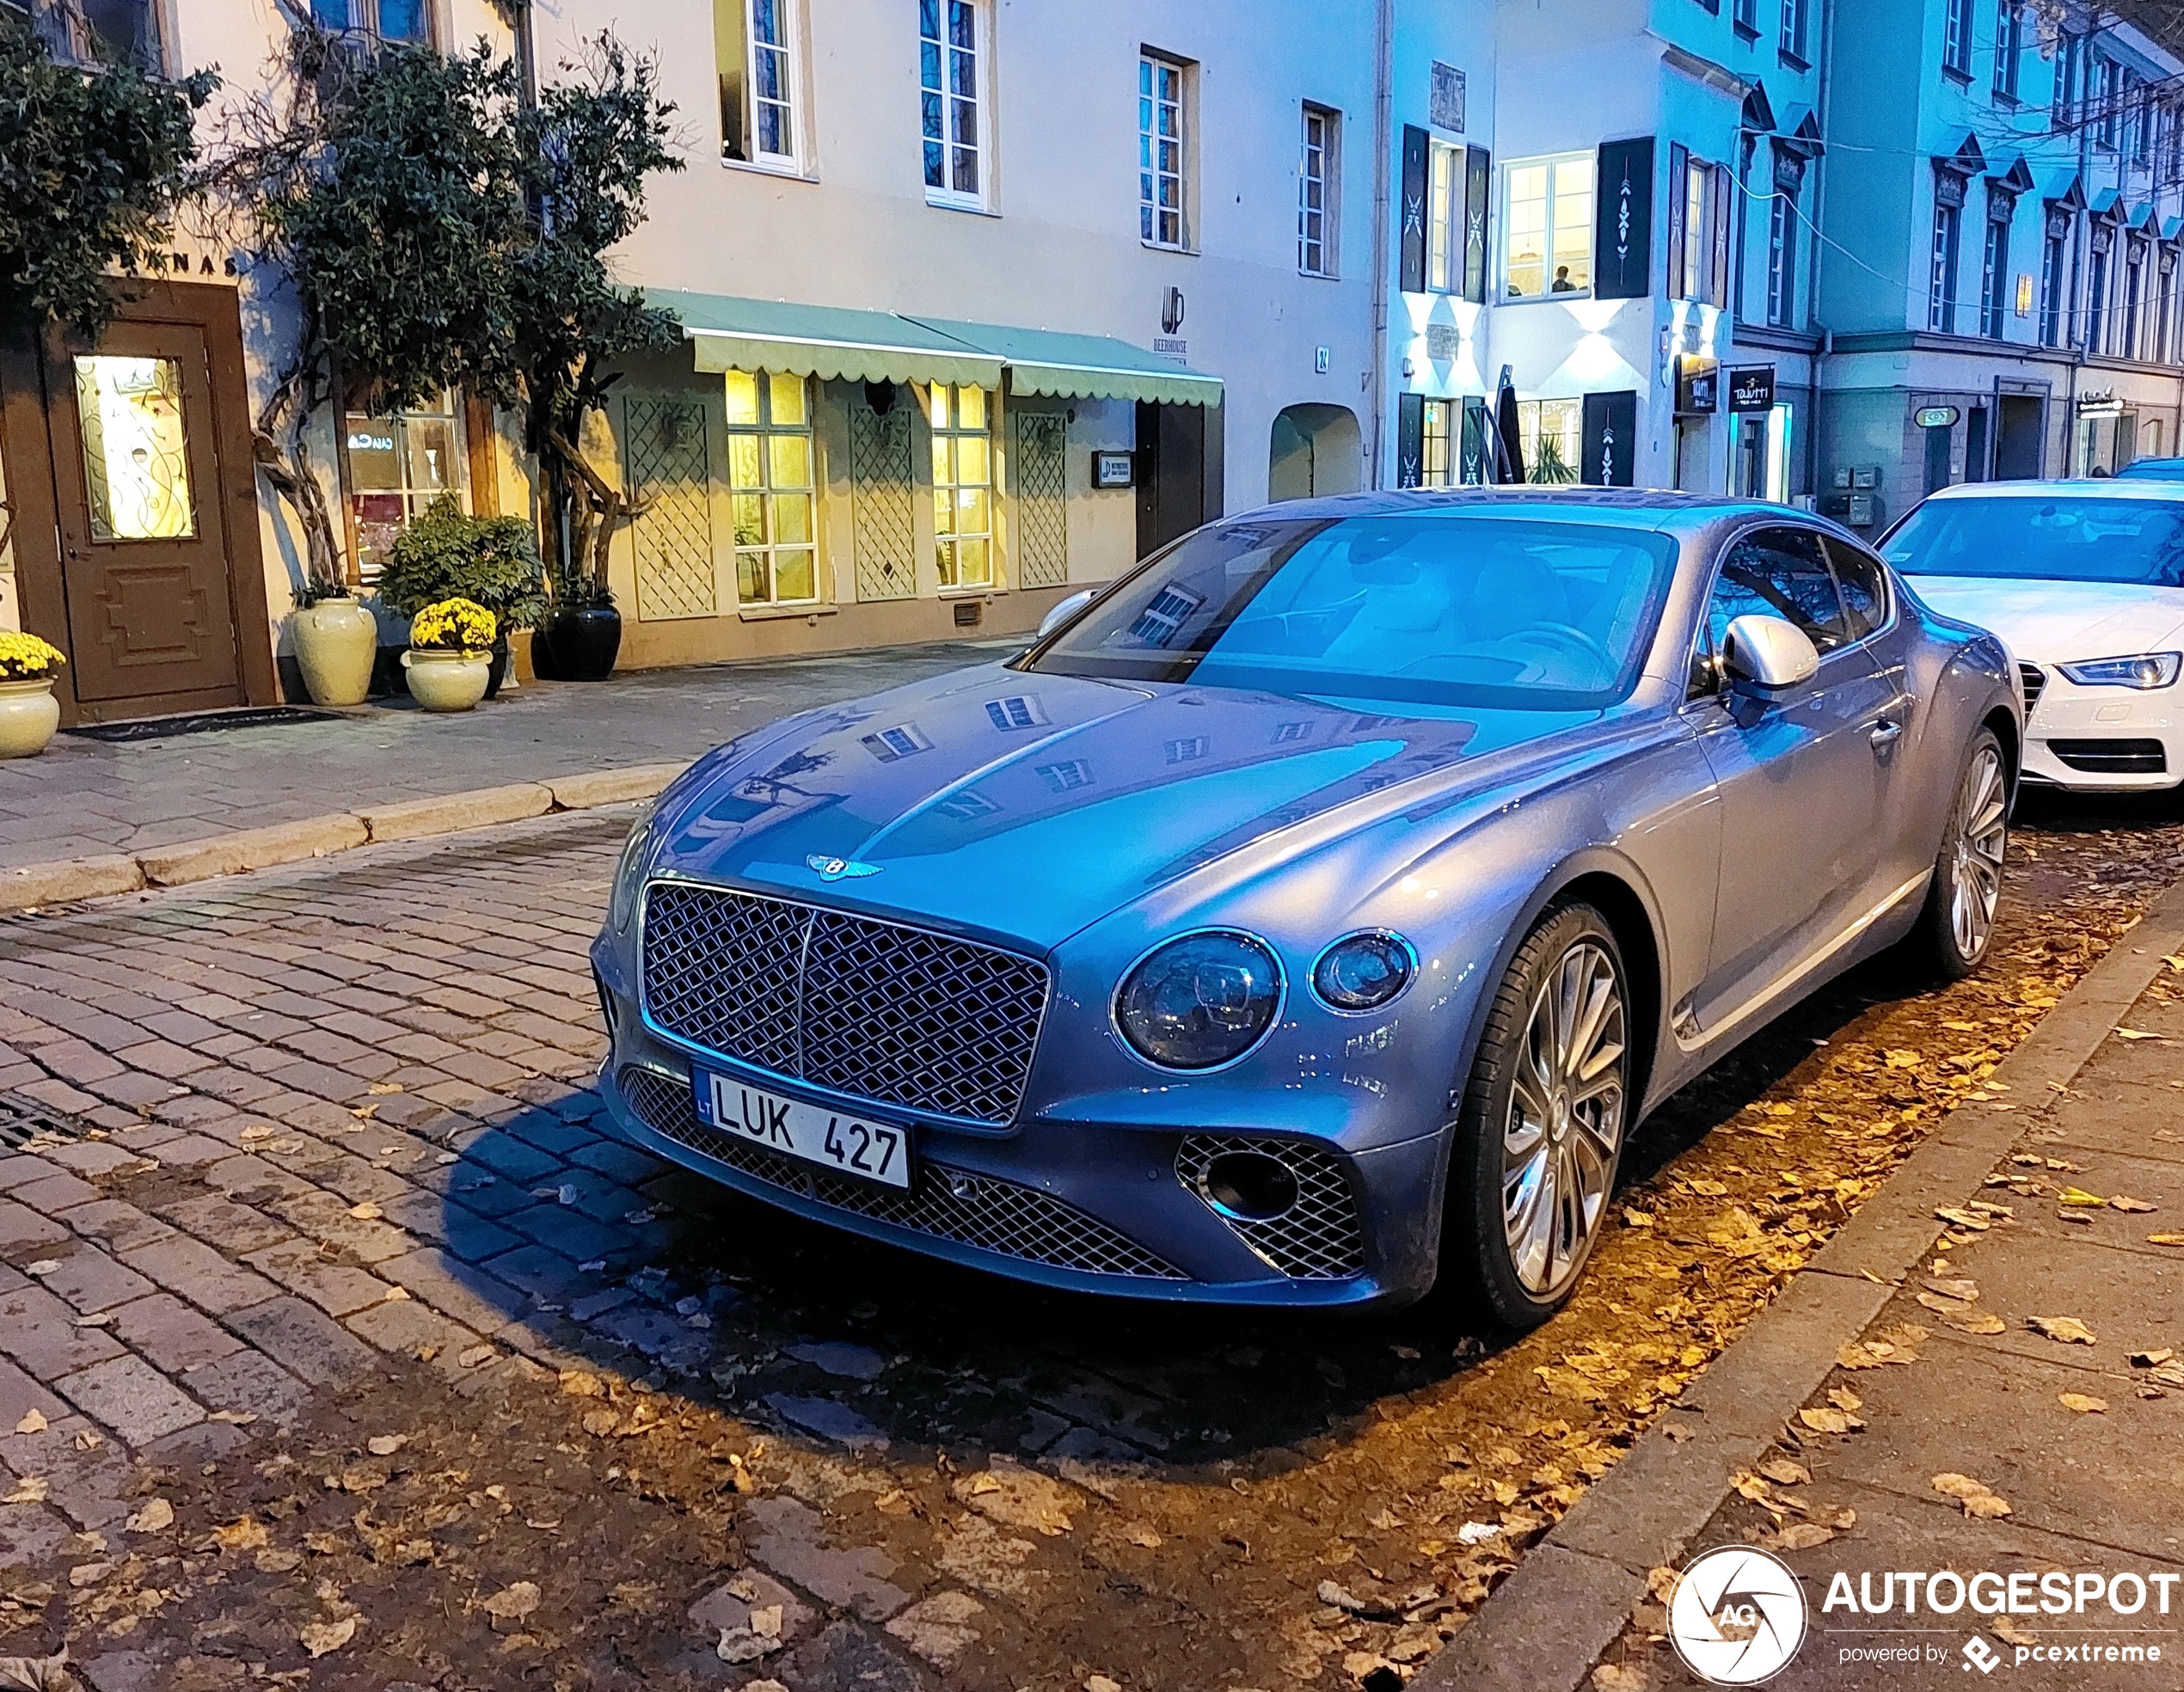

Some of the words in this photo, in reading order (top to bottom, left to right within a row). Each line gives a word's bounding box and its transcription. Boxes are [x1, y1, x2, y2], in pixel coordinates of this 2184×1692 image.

[1153, 338, 1187, 353] BEERHOUSE
[1320, 350, 1328, 369] 24
[1733, 387, 1769, 400] Talutti
[697, 1099, 712, 1116] LT
[715, 1080, 794, 1149] LUK
[824, 1117, 898, 1176] 427
